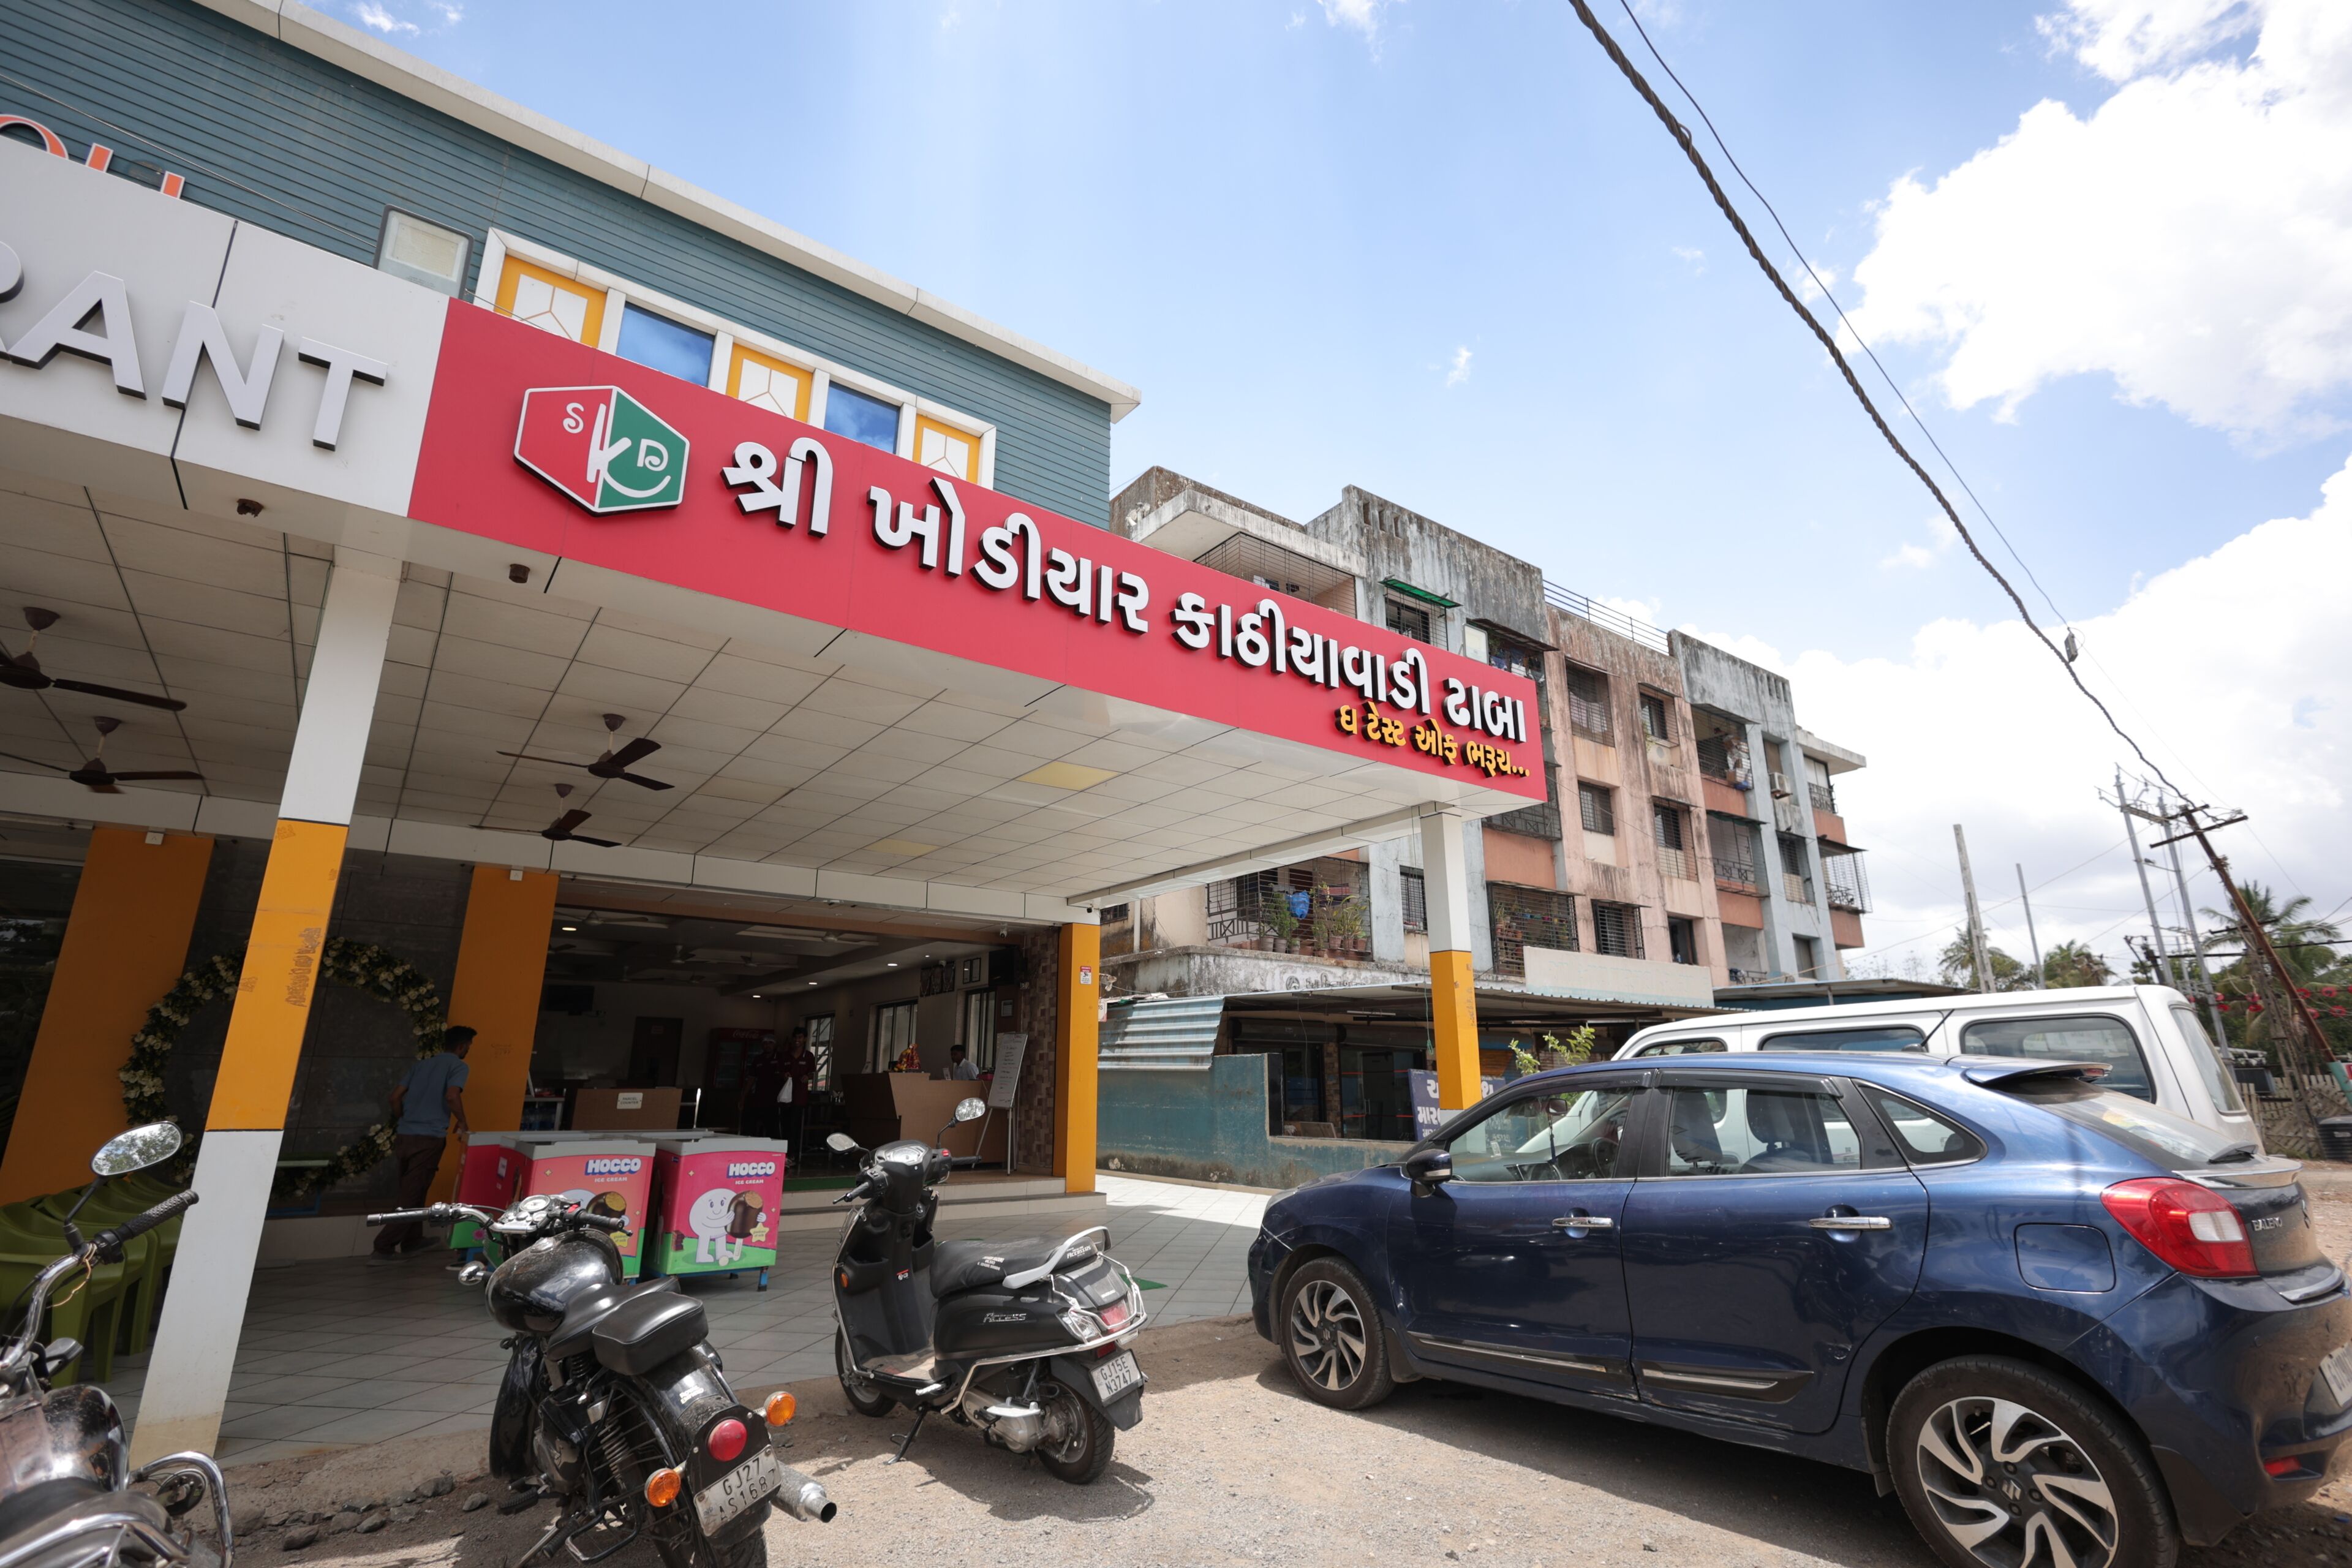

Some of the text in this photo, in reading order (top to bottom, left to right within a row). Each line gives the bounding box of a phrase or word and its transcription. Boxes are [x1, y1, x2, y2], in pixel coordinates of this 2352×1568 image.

[0, 241, 388, 451] ANT
[721, 437, 1528, 744] શ્રી ખોડીયાર કાઠીયાવાડી ઢાબા
[585, 1158, 641, 1175] HOCCO
[726, 1161, 775, 1178] HOCCO
[2251, 1216, 2283, 1232] BALENO
[1100, 1356, 1128, 1381] GJ15E
[1105, 1370, 1132, 1395] N3747
[723, 1457, 760, 1496] GJ27
[718, 1468, 776, 1521] AS1687
